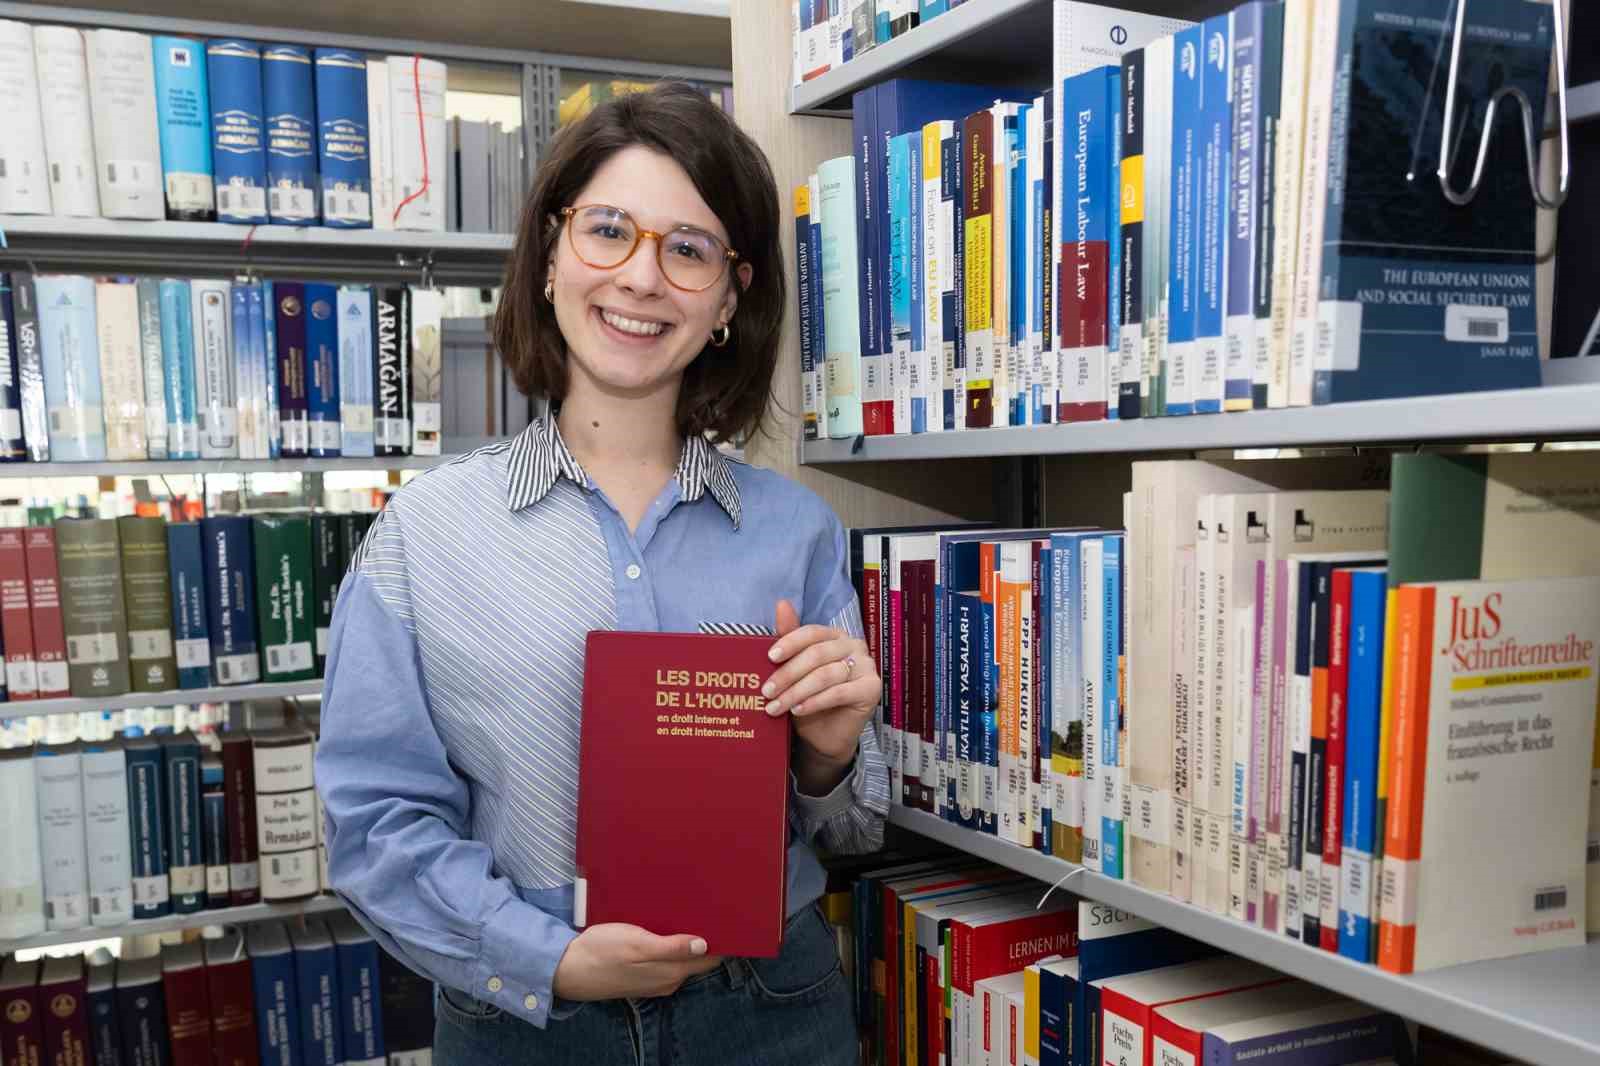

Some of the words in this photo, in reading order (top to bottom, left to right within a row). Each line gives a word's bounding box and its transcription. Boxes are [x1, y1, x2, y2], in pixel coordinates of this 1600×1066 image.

[1241, 64, 1253, 118] SOCIAL
[1076, 109, 1091, 193] European
[1240, 119, 1252, 150] LAW
[1239, 157, 1251, 185] AND
[926, 188, 938, 232] Foster
[1077, 197, 1090, 259] Labour
[1237, 188, 1250, 241] POLICY
[911, 217, 919, 256] EUROPEAN
[799, 242, 808, 283] AVRUPA
[892, 256, 903, 301] LAW
[1077, 262, 1090, 299] Law
[1384, 268, 1407, 285] THE
[1411, 269, 1479, 286] EUROPEAN
[1482, 272, 1530, 289] UNION
[927, 285, 937, 323] LAW
[1357, 289, 1384, 304] AND
[1388, 290, 1432, 305] SOCIAL
[1437, 292, 1499, 306] SECURITY
[1502, 294, 1530, 307] LAW
[801, 320, 812, 348] KAMU
[377, 300, 401, 412] ARMAĞAN
[1053, 548, 1064, 609] European
[1062, 548, 1072, 595] Kingston,
[1105, 577, 1113, 619] ESSENTIAL
[982, 612, 991, 650] Avrupa
[1021, 616, 1030, 649] PPP
[1441, 592, 1503, 655] JuS
[1053, 612, 1064, 694] Environmental
[1105, 631, 1113, 663] CLIMATE
[1451, 632, 1594, 673] Schriftenreihe
[656, 669, 690, 686] LES
[695, 671, 760, 689] DROITS
[1105, 664, 1113, 684] LAW
[656, 691, 680, 707] DE
[685, 692, 766, 711] L'HOMME
[983, 682, 991, 713] Kamu
[1020, 656, 1030, 732] HUKUKU
[1085, 679, 1095, 729] AVRUPA
[1175, 672, 1183, 740] TOPLULUĞU
[656, 714, 670, 723] en
[670, 713, 694, 724] droit
[695, 714, 728, 725] interne
[729, 716, 740, 726] et
[656, 726, 669, 736] en
[670, 726, 693, 736] droit
[694, 727, 755, 739] international
[1448, 719, 1515, 741] Einführung
[1517, 716, 1530, 733] in
[1531, 712, 1553, 732] das
[1085, 734, 1095, 782] BİRLİĞİ
[1521, 733, 1555, 753] Recht
[1175, 746, 1183, 795] AVRUPA
[1325, 765, 1339, 853] Strafprozessrecht
[1009, 936, 1053, 960] LERNEN
[1056, 932, 1069, 950] IM
[1112, 1021, 1135, 1042] Fuchs
[1113, 1032, 1133, 1051] Preis
[1236, 1047, 1266, 1061] Soziale
[1267, 1041, 1293, 1055] Arbeit
